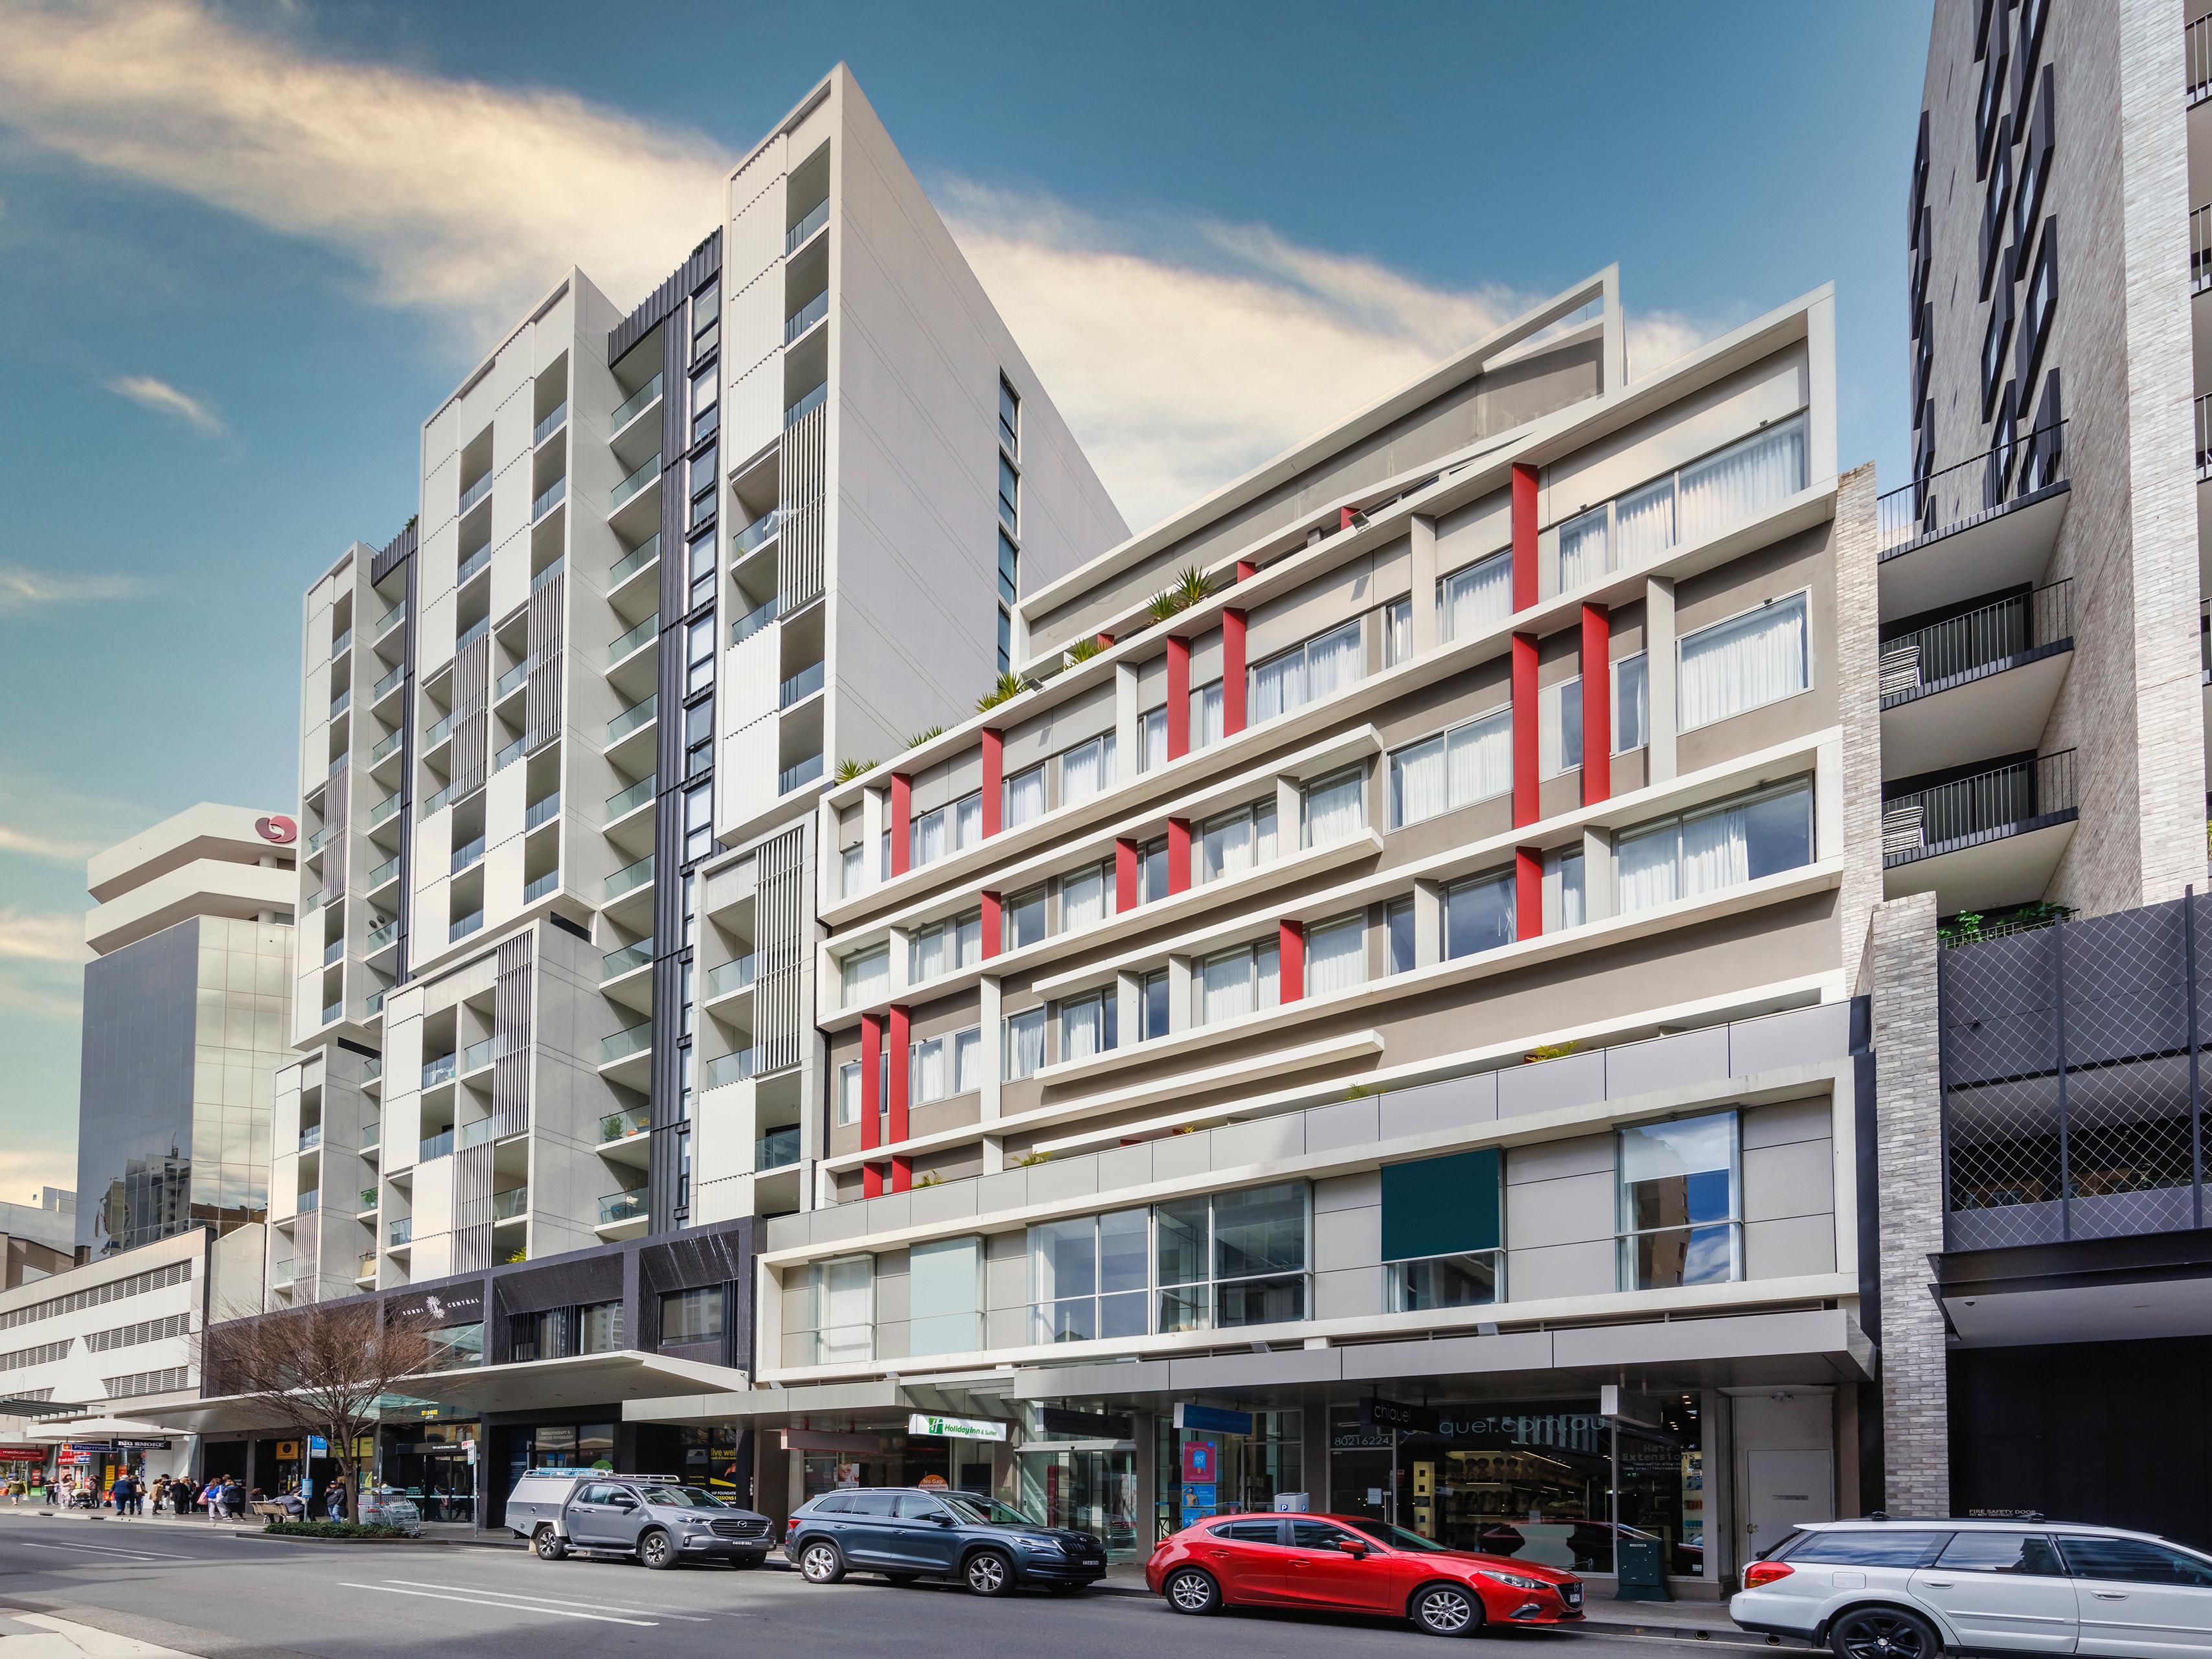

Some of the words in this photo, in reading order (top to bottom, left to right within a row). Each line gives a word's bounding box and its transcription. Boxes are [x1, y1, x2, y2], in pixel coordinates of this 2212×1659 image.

[447, 1298, 480, 1308] CENTRAL
[1374, 1403, 1411, 1424] chiquel
[944, 1424, 970, 1434] Holiday
[1334, 1436, 1389, 1446] 80216224
[710, 1448, 722, 1456] live
[1622, 1453, 1695, 1461] Extensions
